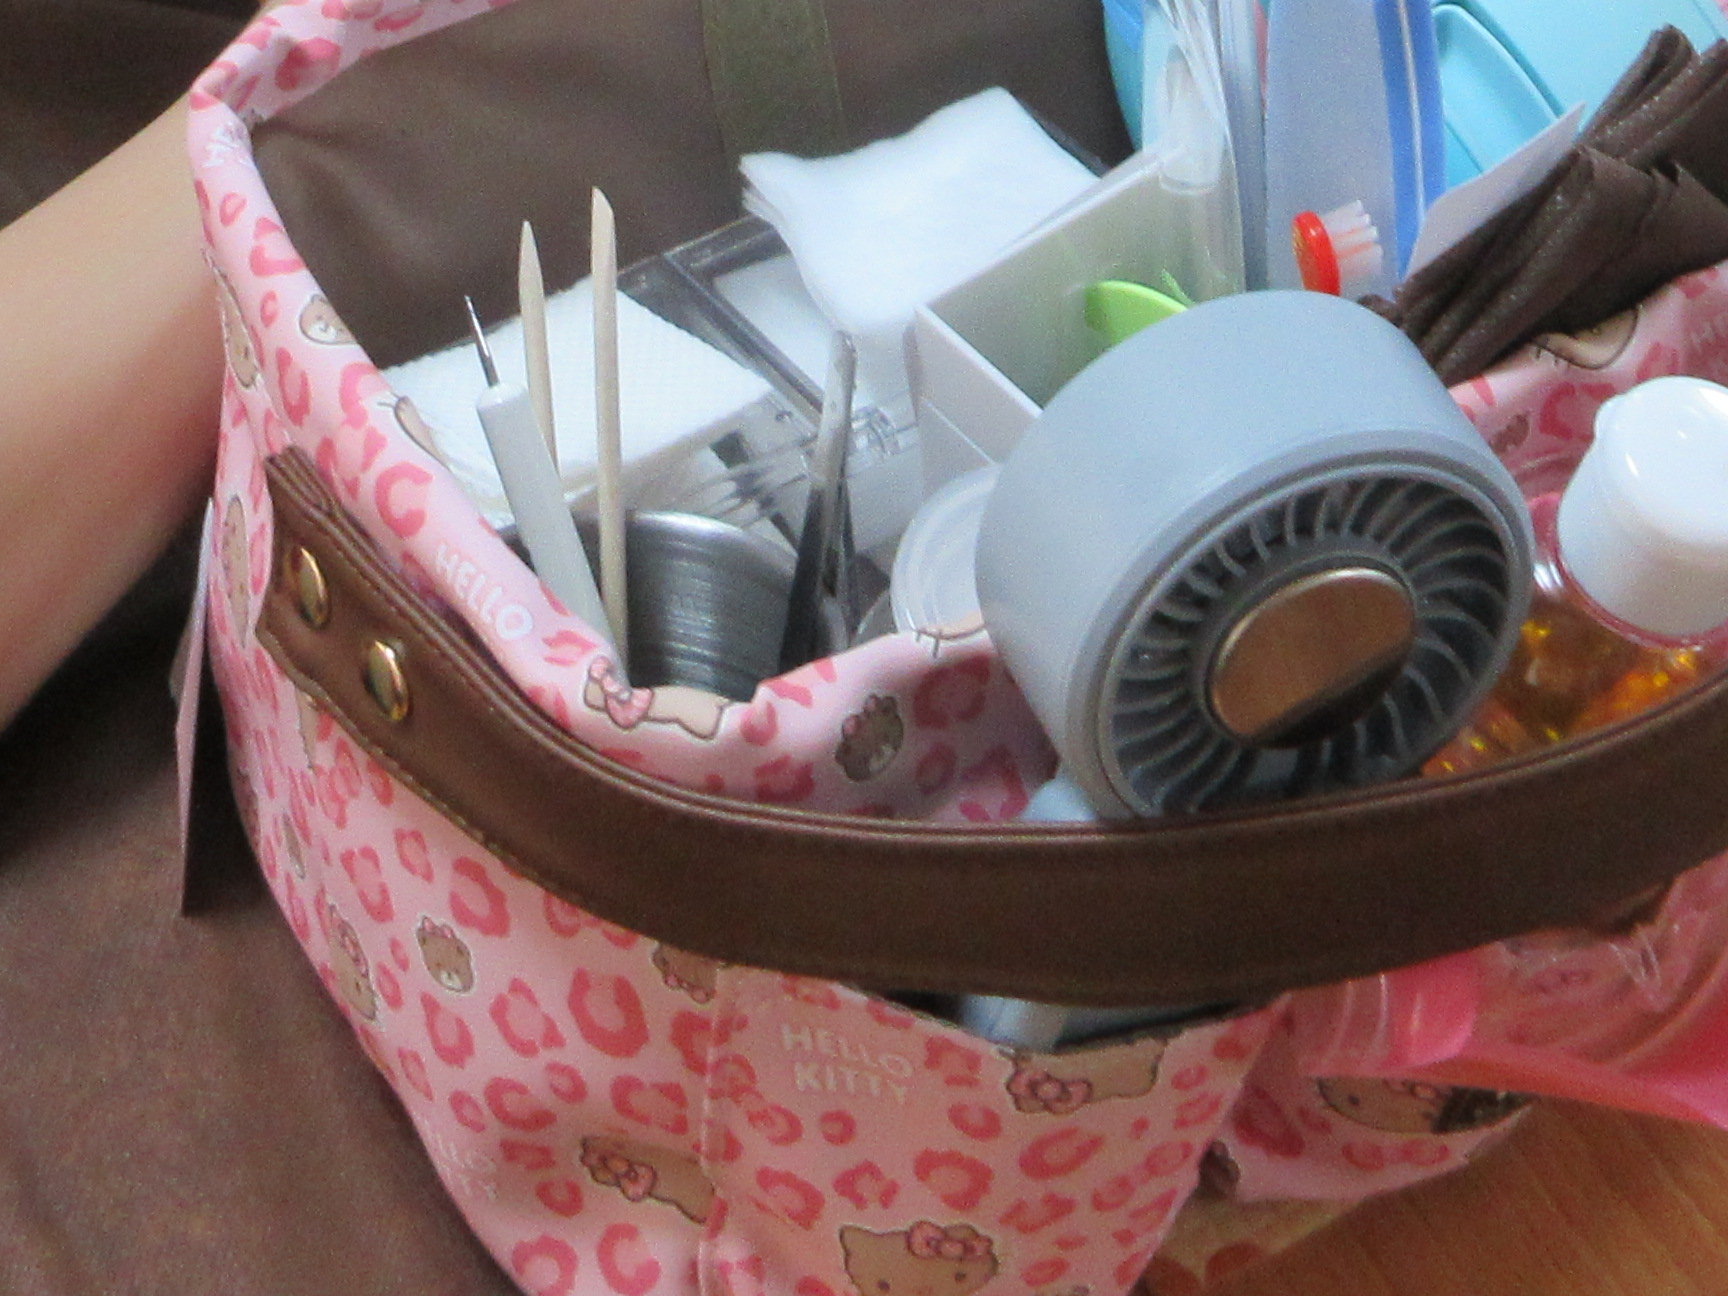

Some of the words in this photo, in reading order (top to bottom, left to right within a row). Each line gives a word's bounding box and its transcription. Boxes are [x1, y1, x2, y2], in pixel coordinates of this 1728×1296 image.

[435, 543, 534, 641] HELLO
[780, 1023, 915, 1079] HELLO
[793, 1061, 909, 1106] KITTY
